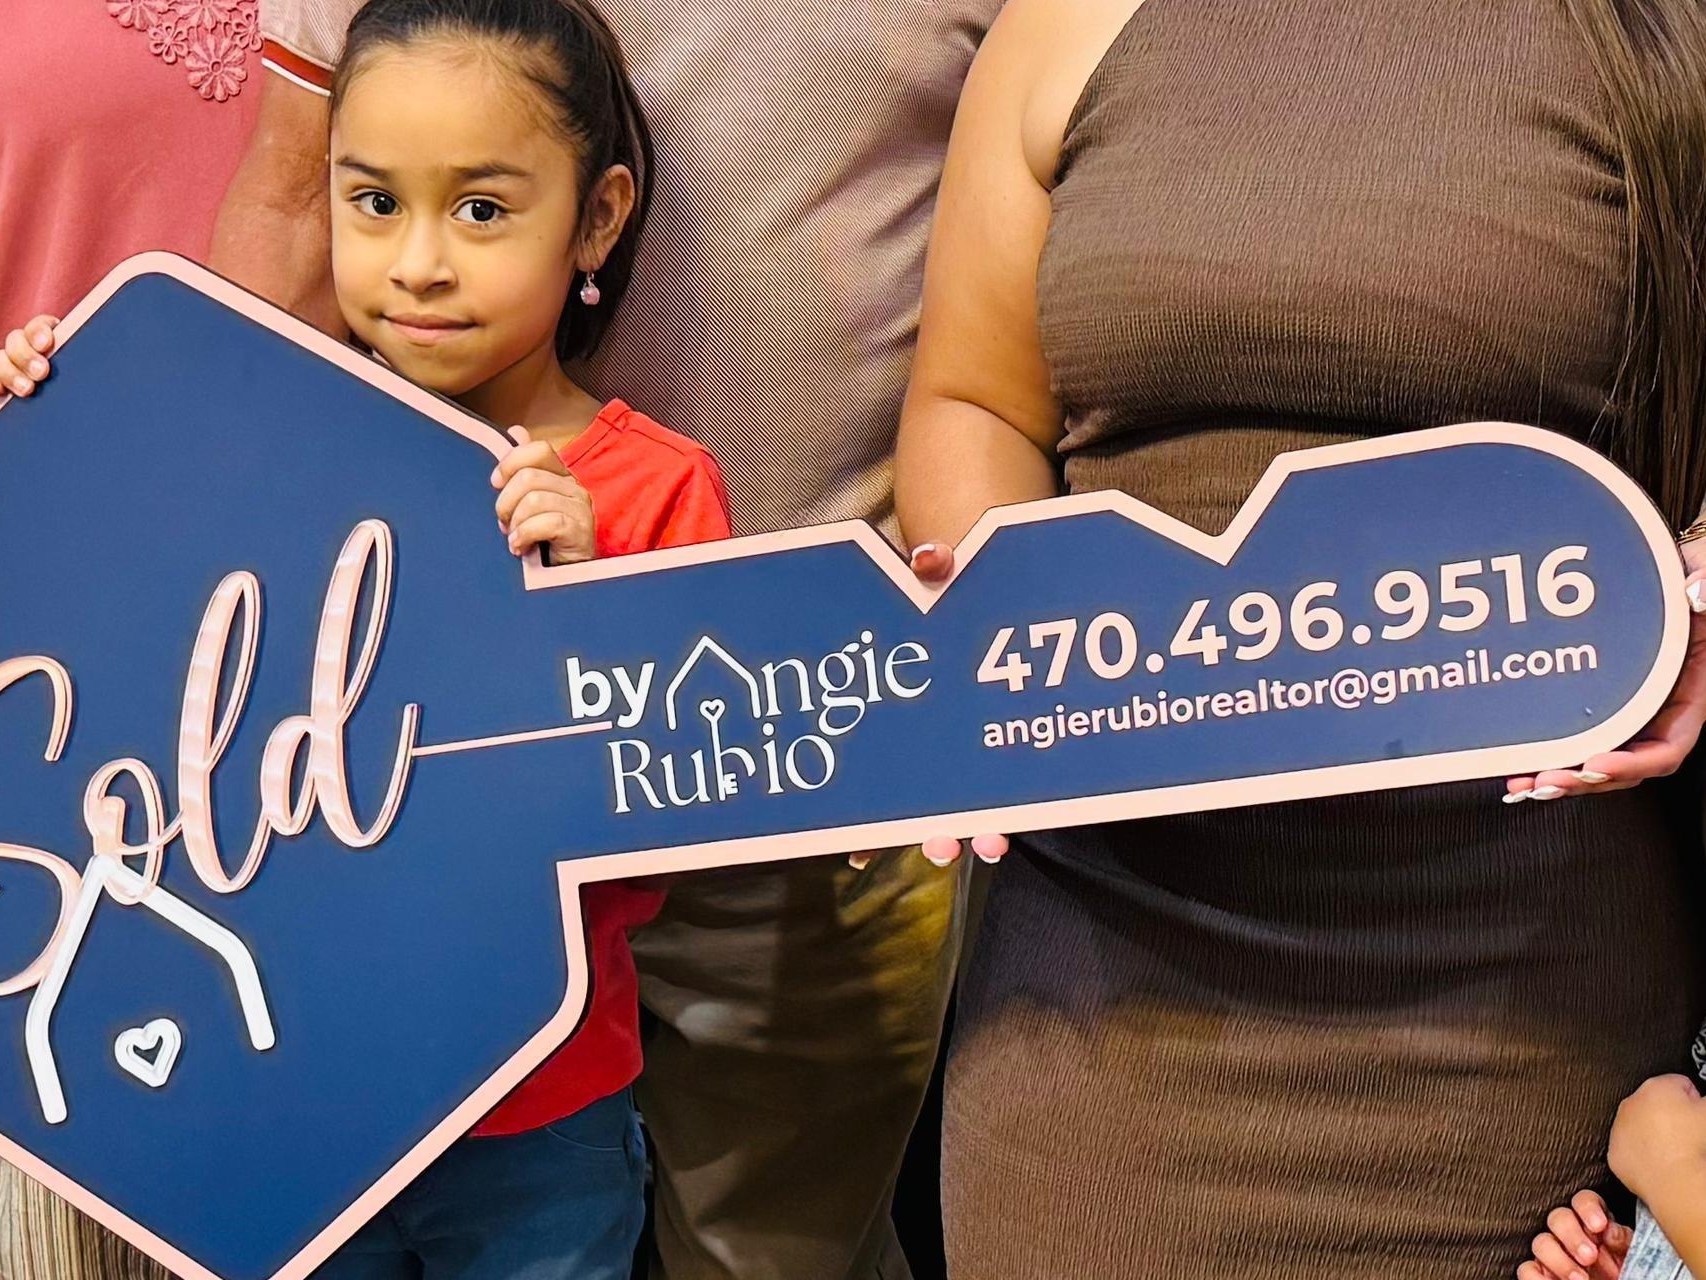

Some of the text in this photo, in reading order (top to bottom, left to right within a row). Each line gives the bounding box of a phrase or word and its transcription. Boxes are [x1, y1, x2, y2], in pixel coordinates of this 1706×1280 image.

[975, 545, 1598, 694] 470.496.9516
[565, 629, 933, 737] by Angie
[982, 640, 1598, 751] angierubiorealtor@gmail.com
[607, 699, 836, 814] Rubio
